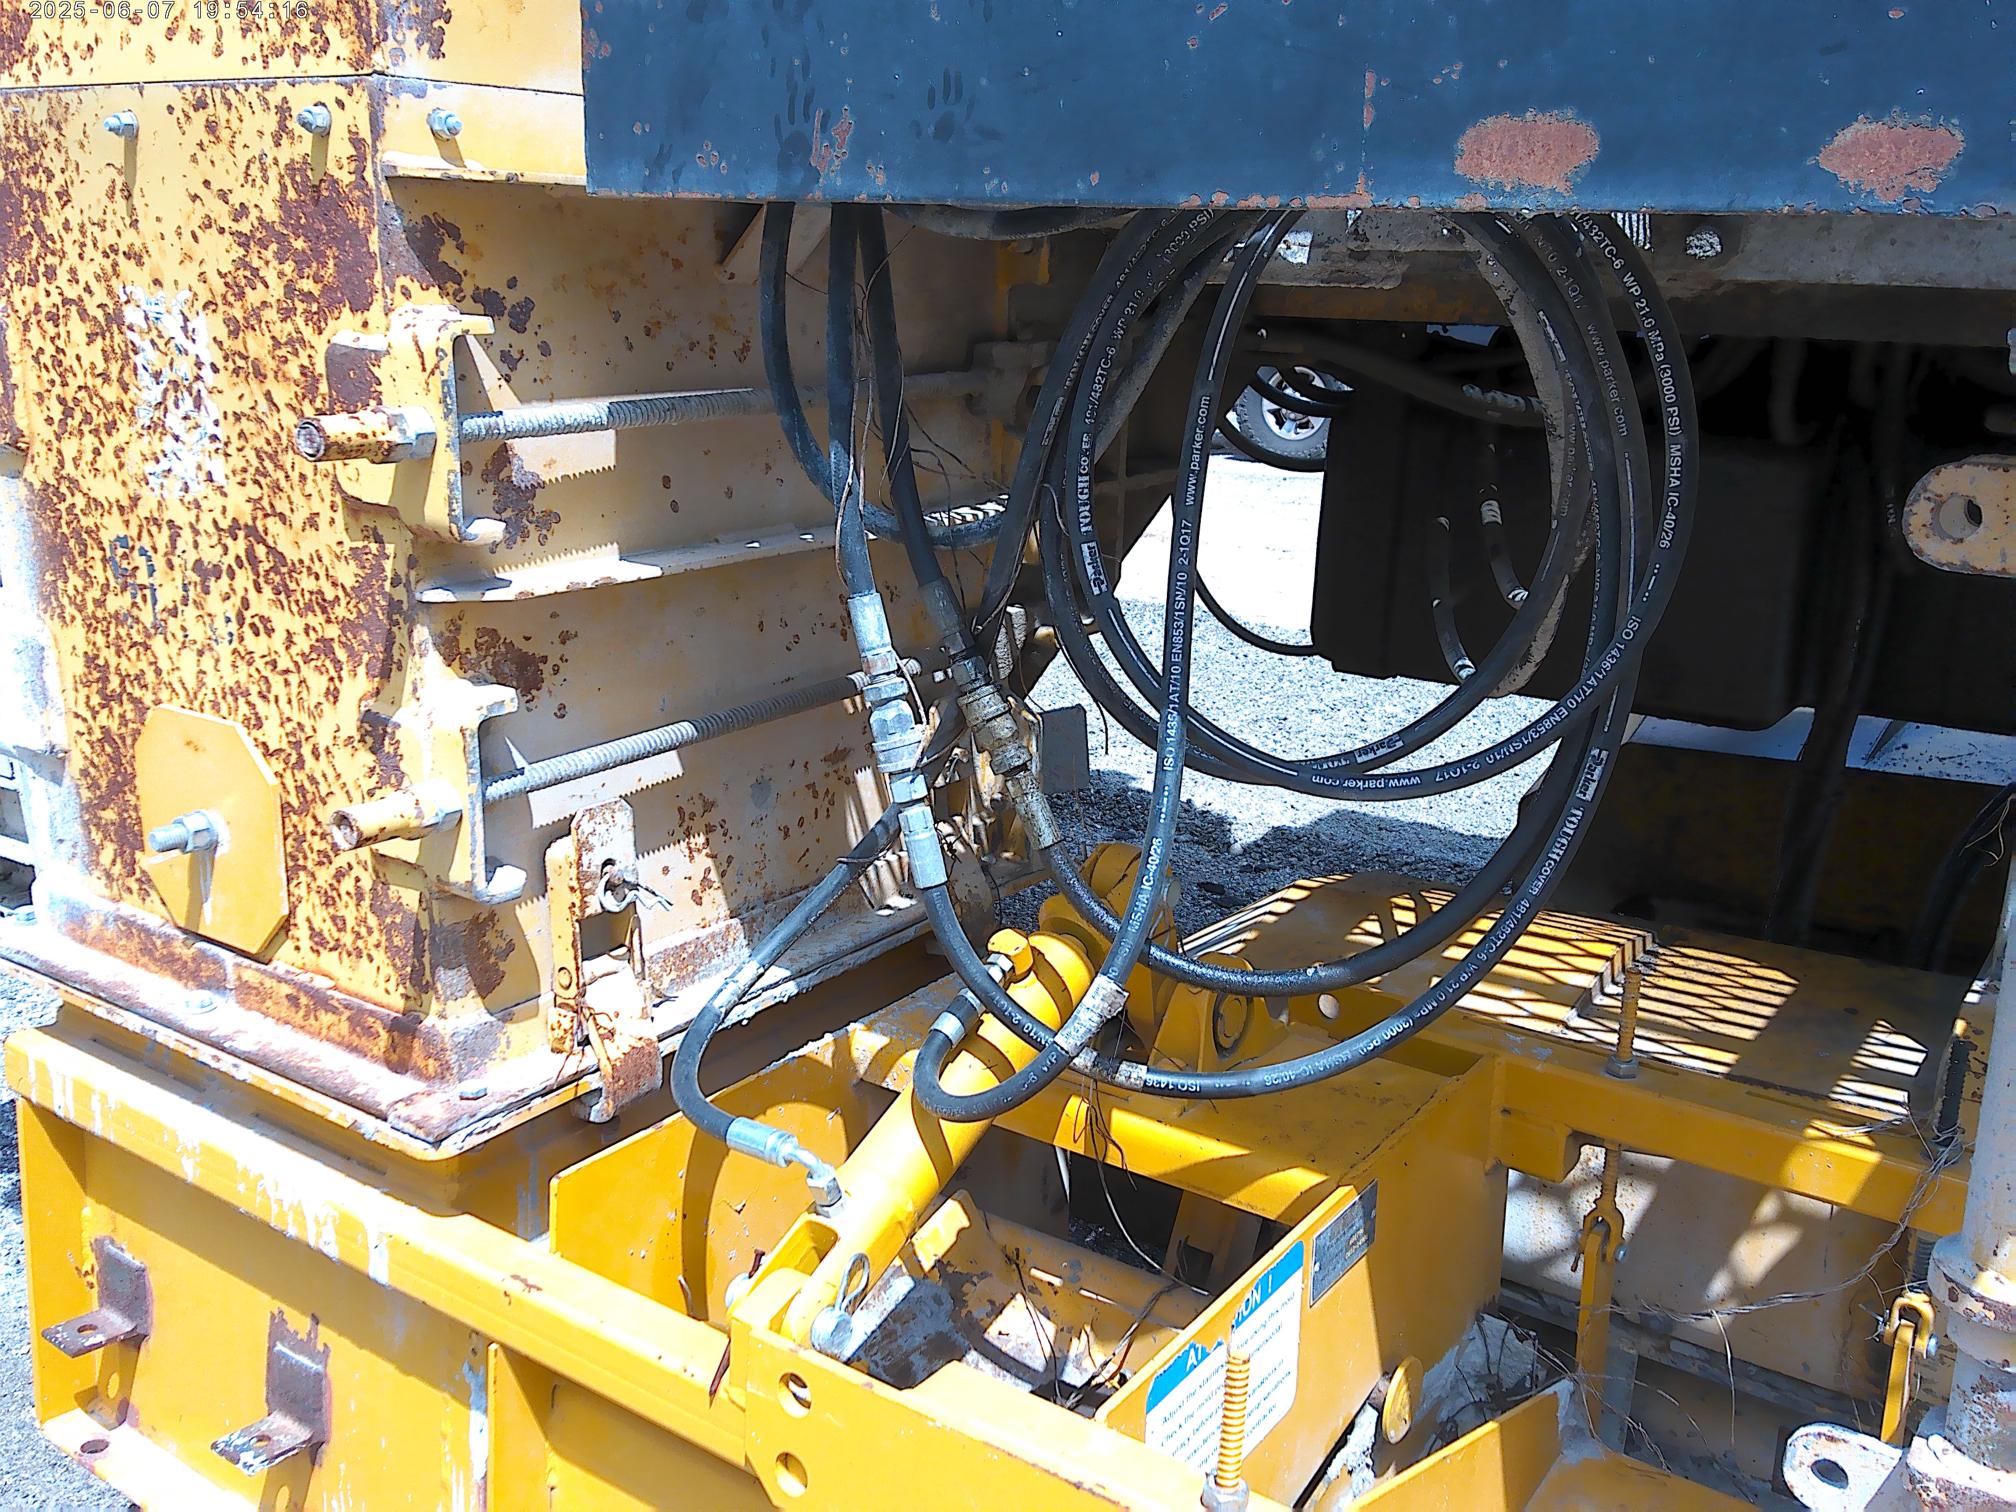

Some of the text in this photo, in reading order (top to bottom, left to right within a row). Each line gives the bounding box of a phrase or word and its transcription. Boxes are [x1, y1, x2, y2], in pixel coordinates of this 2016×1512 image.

[1622, 272, 1642, 297] WP
[1657, 364, 1677, 403] (3000
[1666, 406, 1682, 436] PSI)
[1185, 395, 1210, 506] www.parker.com
[1668, 444, 1682, 488] MSHA
[1659, 492, 1680, 549] IC-40/26
[1178, 520, 1192, 565] 2-1Q17
[1171, 572, 1188, 662] EN853/1SN/10
[1621, 615, 1642, 640] ISO
[1567, 641, 1625, 709] 1436/1AT/10
[1165, 667, 1182, 743] 1436/1AT/10
[1163, 747, 1175, 771] ISO
[1353, 733, 1404, 764] Parker
[1312, 775, 1421, 791] www.parker.com
[1576, 747, 1610, 803] Parker
[1141, 837, 1163, 891] IC-40/26
[1127, 893, 1150, 933] MSHA
[1177, 1080, 1200, 1093] ISO
